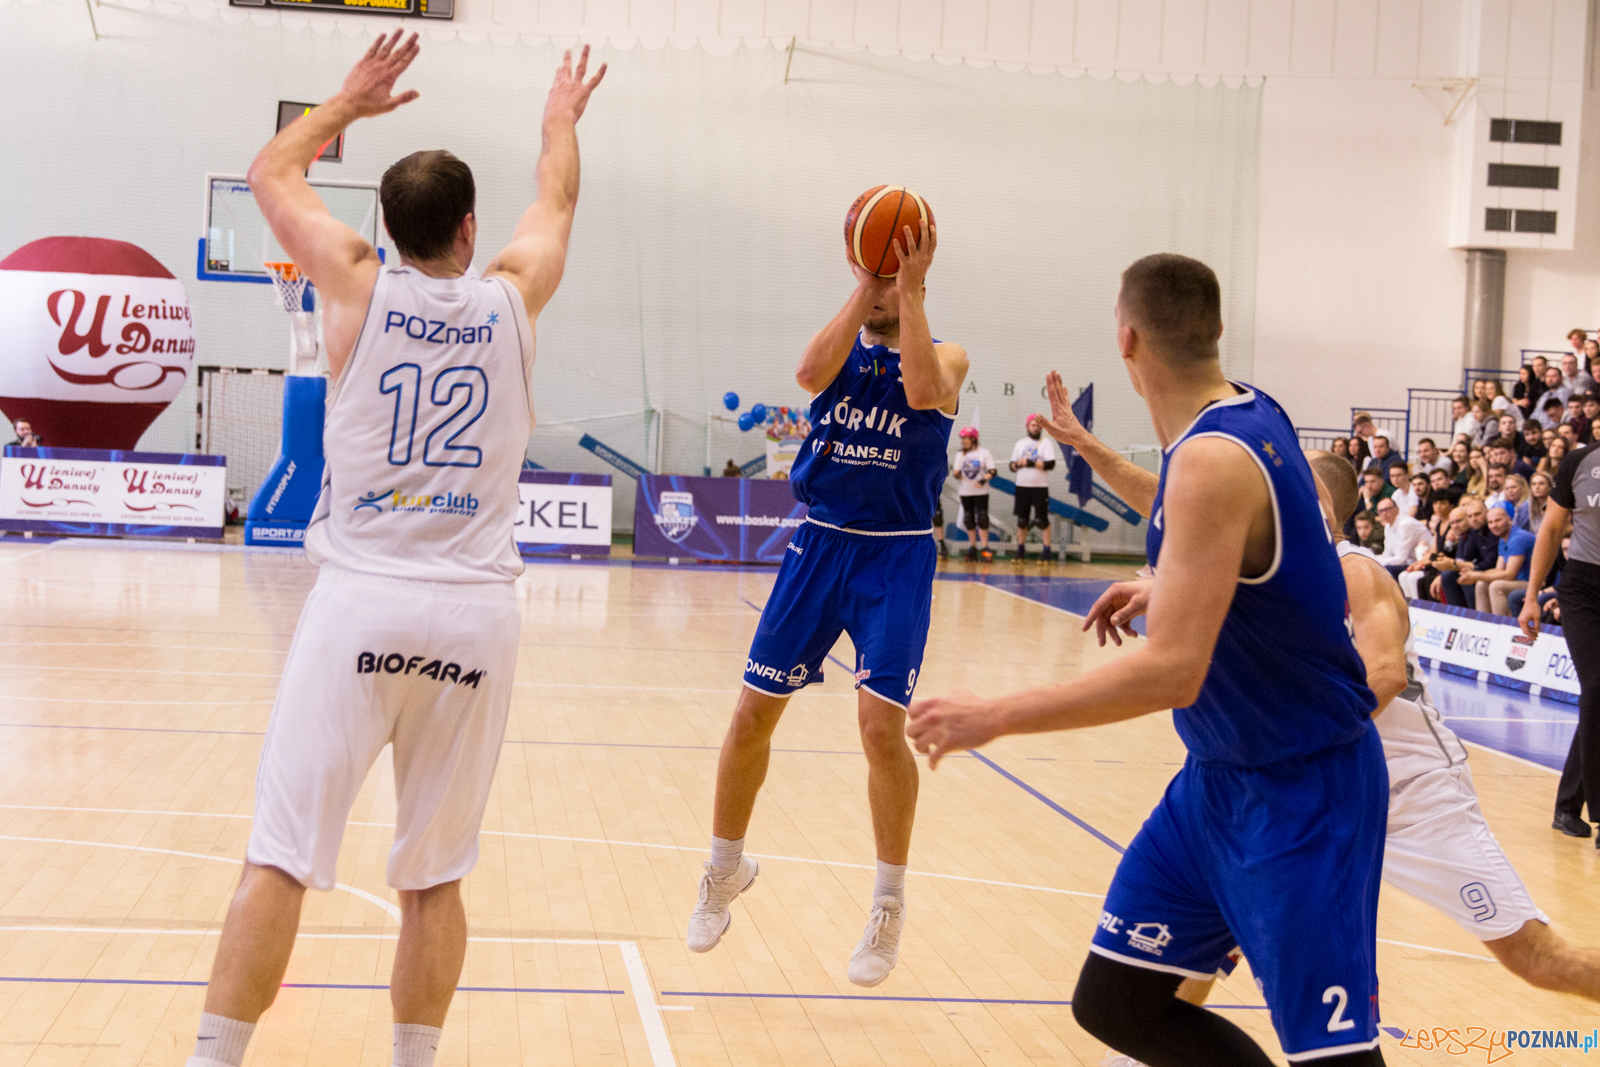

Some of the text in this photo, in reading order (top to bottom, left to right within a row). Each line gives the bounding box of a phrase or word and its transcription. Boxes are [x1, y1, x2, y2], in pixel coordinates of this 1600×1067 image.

[46, 289, 112, 358] U
[379, 362, 489, 468] 12
[832, 440, 901, 462] TRANS.EU
[20, 464, 97, 490] U leniwej
[48, 478, 100, 494] Danuty
[123, 468, 199, 494] U leniwej
[150, 482, 202, 498] Danuty
[265, 460, 297, 514] HYDROPLAY
[392, 491, 479, 510] funclub
[1456, 631, 1491, 657] NICKEL
[905, 668, 916, 696] 9
[1460, 881, 1497, 923] 9
[1322, 985, 1355, 1033] 2
